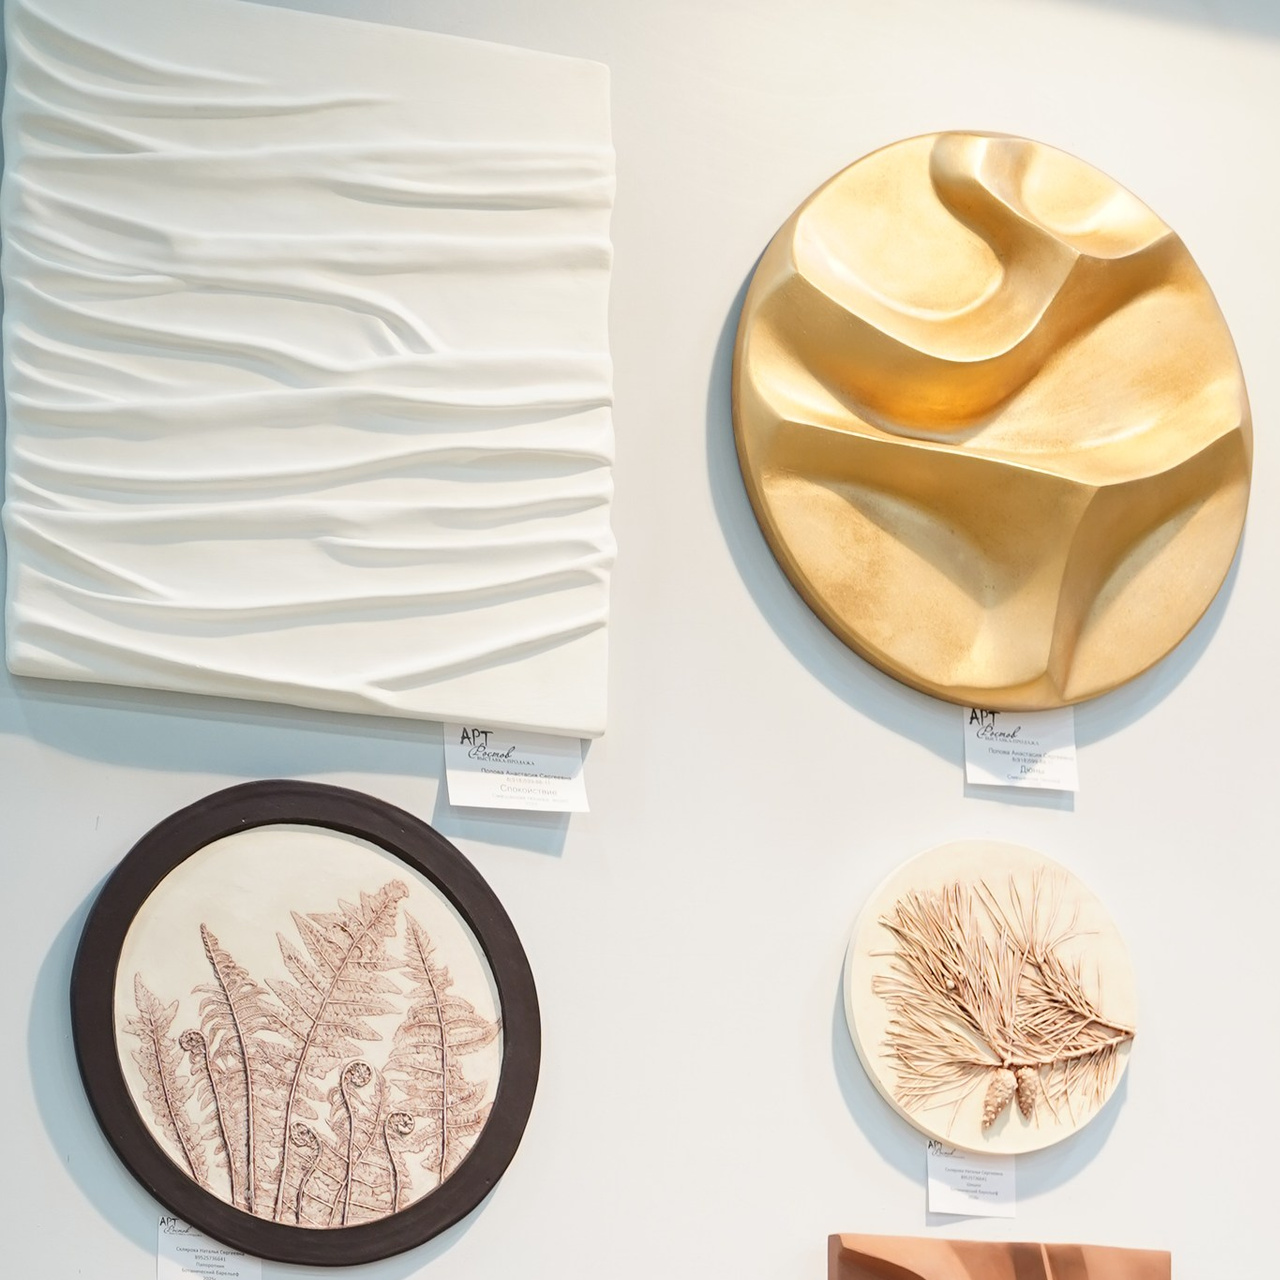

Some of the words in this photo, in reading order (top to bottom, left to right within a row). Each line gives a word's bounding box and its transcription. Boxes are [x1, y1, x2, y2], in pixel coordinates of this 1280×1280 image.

[969, 708, 1001, 726] АРТ
[460, 726, 494, 746] АРТ
[977, 723, 1022, 739] Ростов
[468, 743, 516, 759] Ростов
[159, 1216, 179, 1226] АРТ
